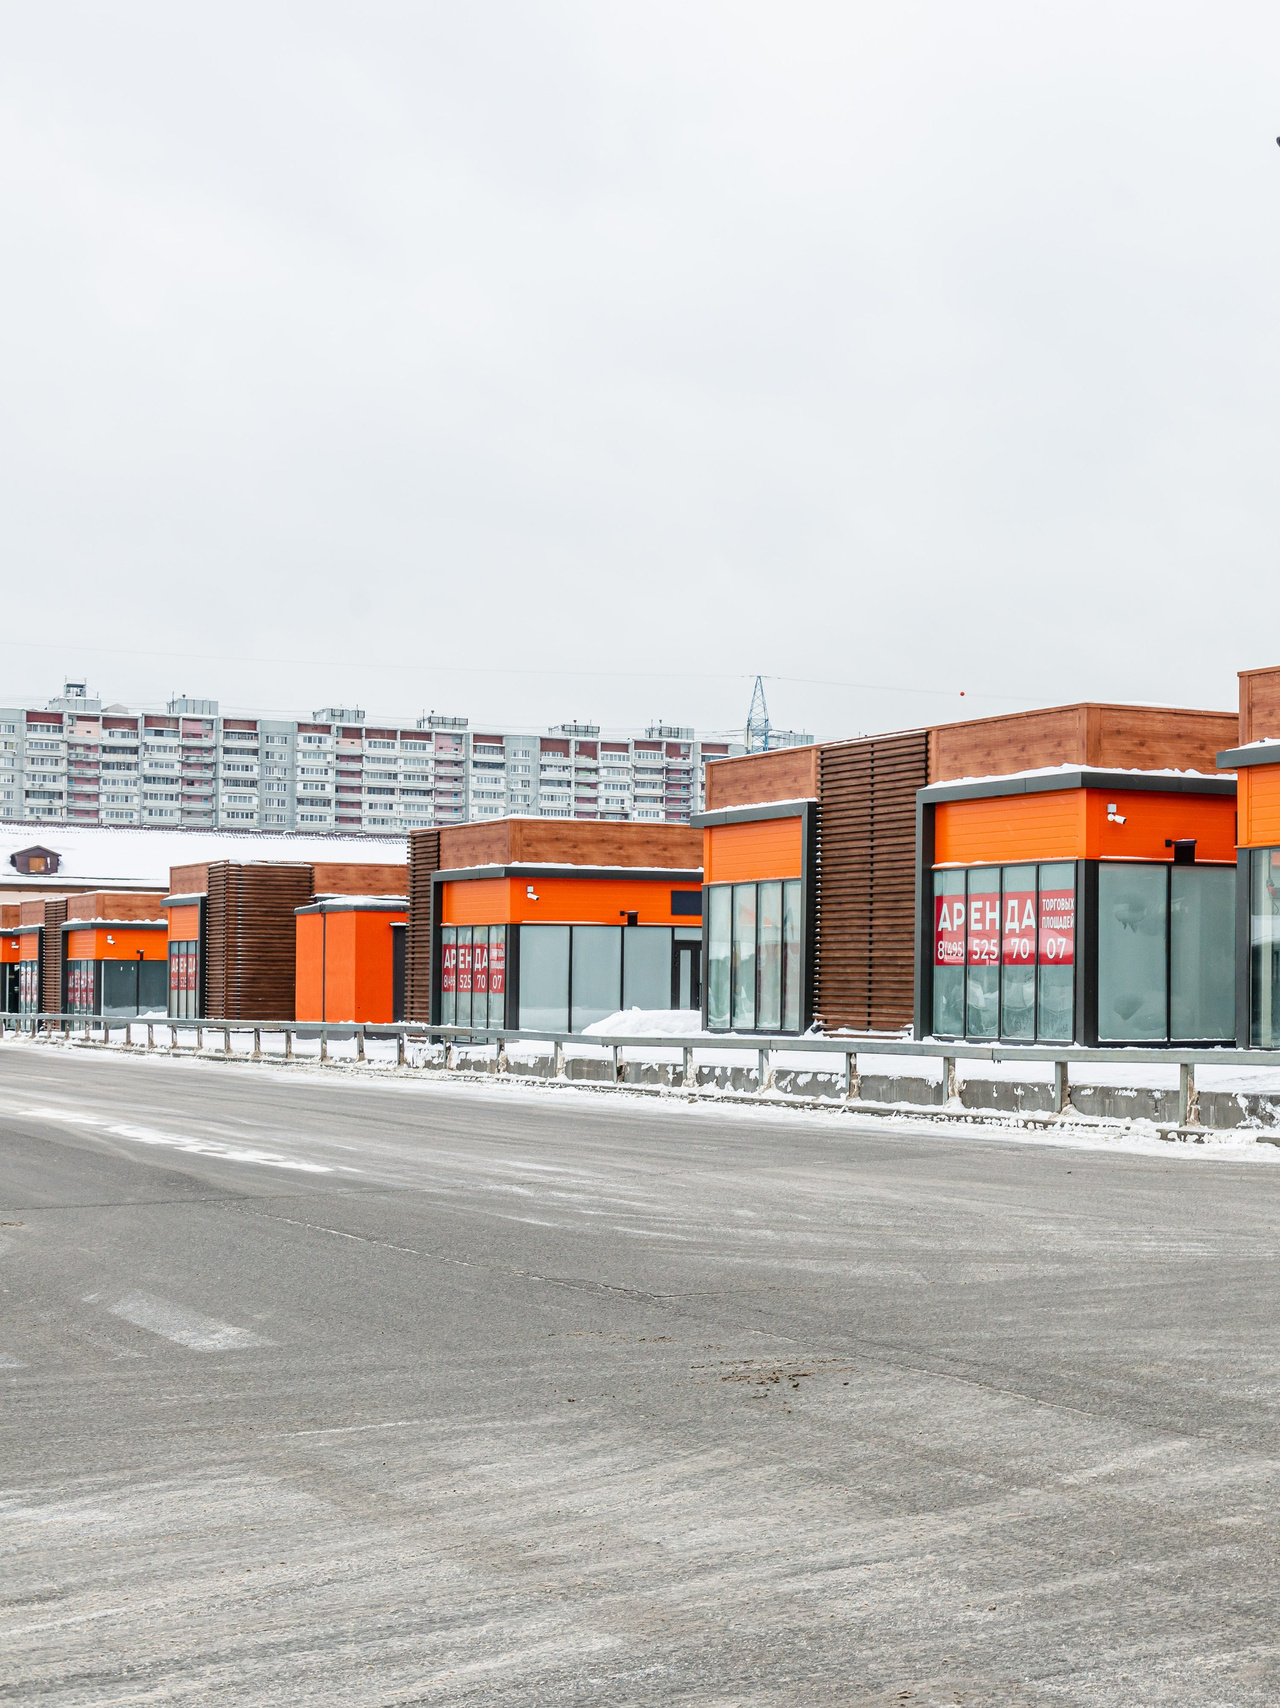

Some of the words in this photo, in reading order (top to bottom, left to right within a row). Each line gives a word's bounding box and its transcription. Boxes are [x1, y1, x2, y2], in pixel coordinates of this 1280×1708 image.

[1042, 897, 1075, 911] ТОРГОВЫХ
[938, 899, 1036, 934] АРЕНДА
[1042, 912, 1075, 930] ПЛОЩАДЕЙ
[972, 939, 998, 960] 525
[1011, 938, 1030, 959] 70
[1046, 938, 1067, 959] 07
[443, 948, 488, 971] АРЕНДА
[459, 974, 471, 989] 525
[476, 974, 486, 989] 70
[492, 975, 502, 989] 07
